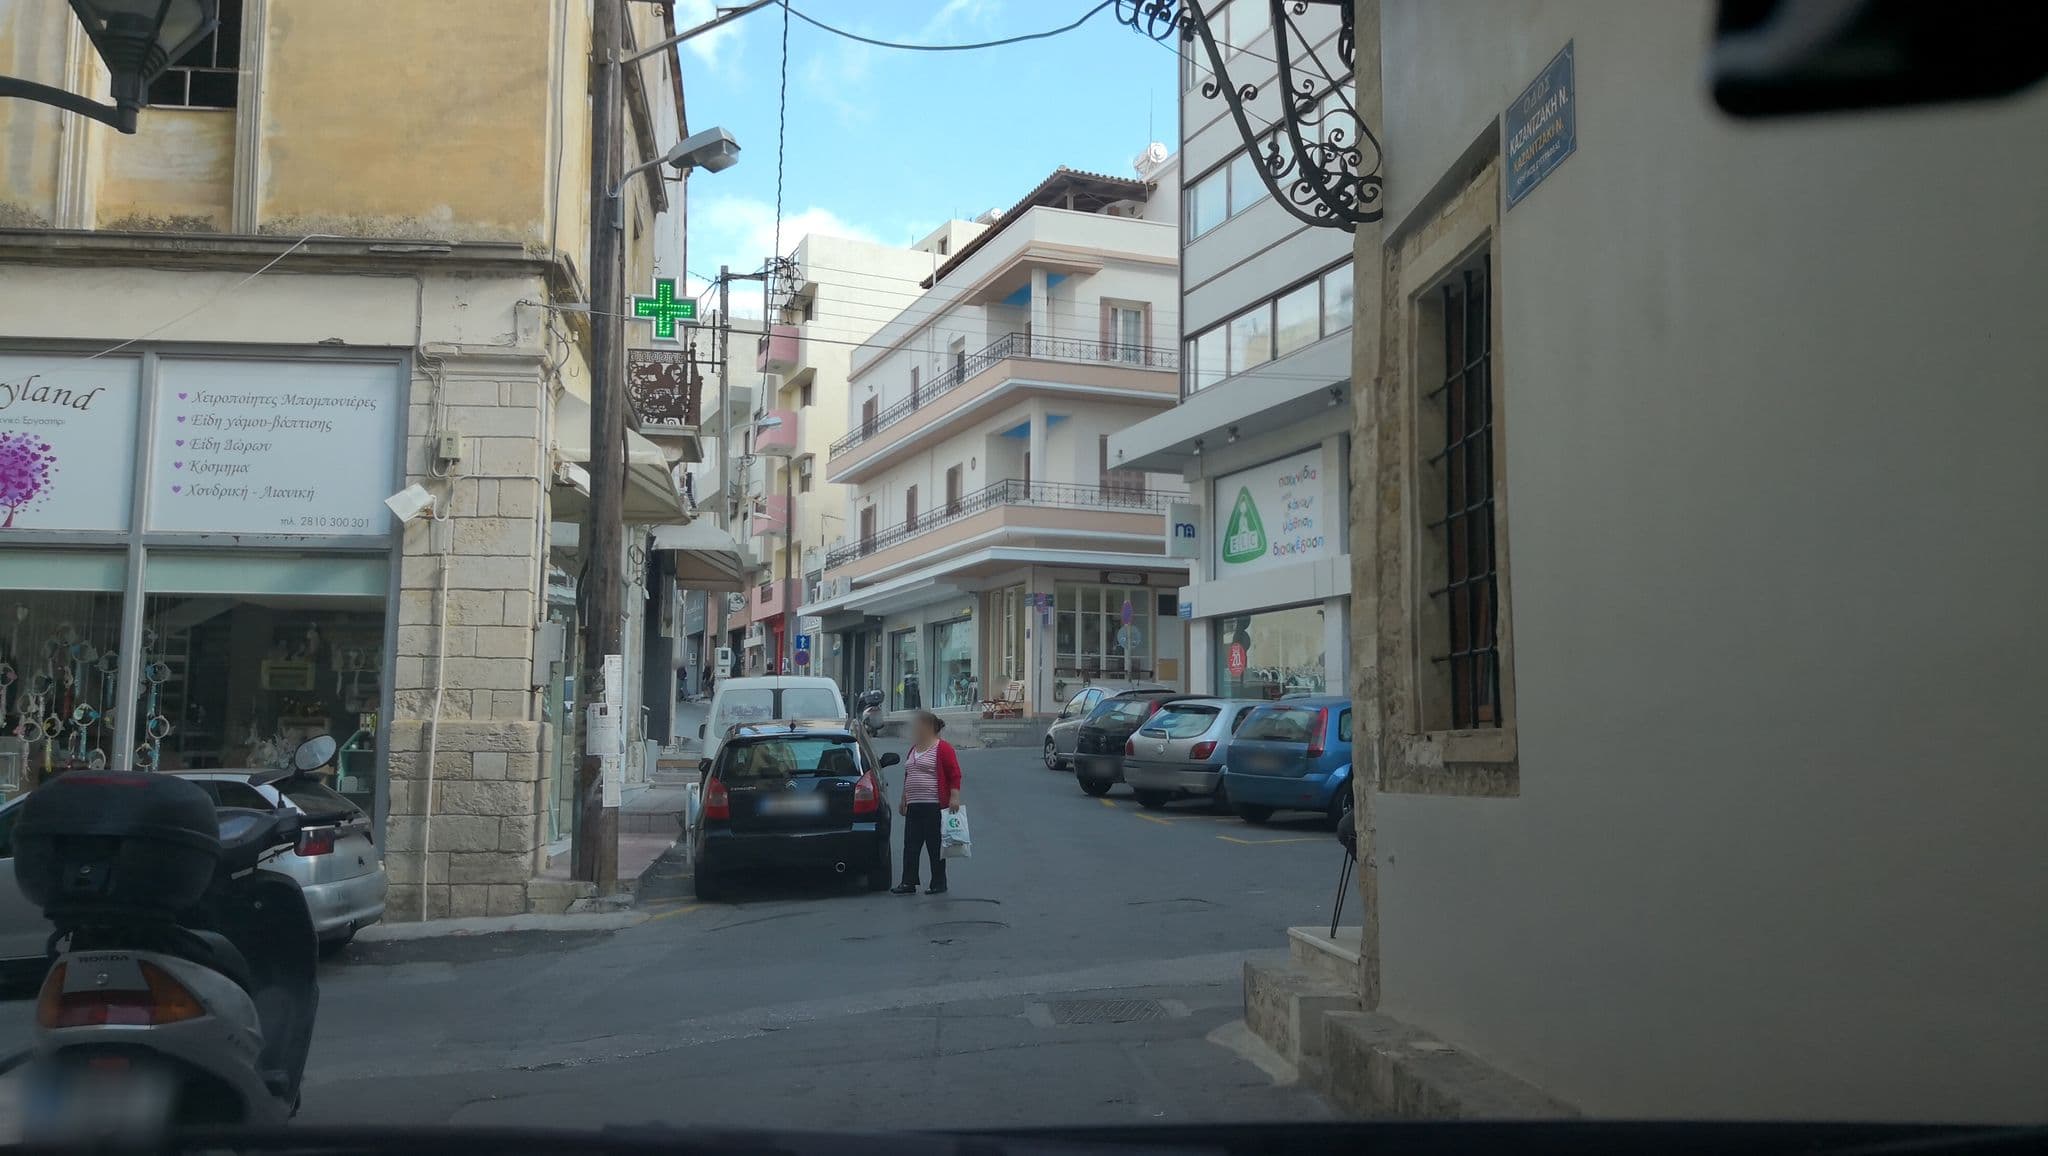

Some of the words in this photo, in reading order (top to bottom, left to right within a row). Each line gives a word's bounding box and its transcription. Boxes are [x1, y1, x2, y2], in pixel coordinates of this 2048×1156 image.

[0, 374, 106, 411] yland
[190, 390, 278, 408] Χειροποίητες
[280, 393, 377, 411] Μπομπονιέρες
[190, 413, 222, 430] Είδη
[223, 414, 333, 432] γάμου-βάπτισης
[189, 437, 221, 453] Είδη
[223, 438, 272, 455] Δώρων
[188, 459, 251, 476] Κόσμημα
[186, 483, 249, 501] Χονδρική
[258, 485, 316, 502] Λιανική
[300, 516, 326, 527] 2810
[329, 517, 350, 527] 300
[351, 518, 370, 528] 301
